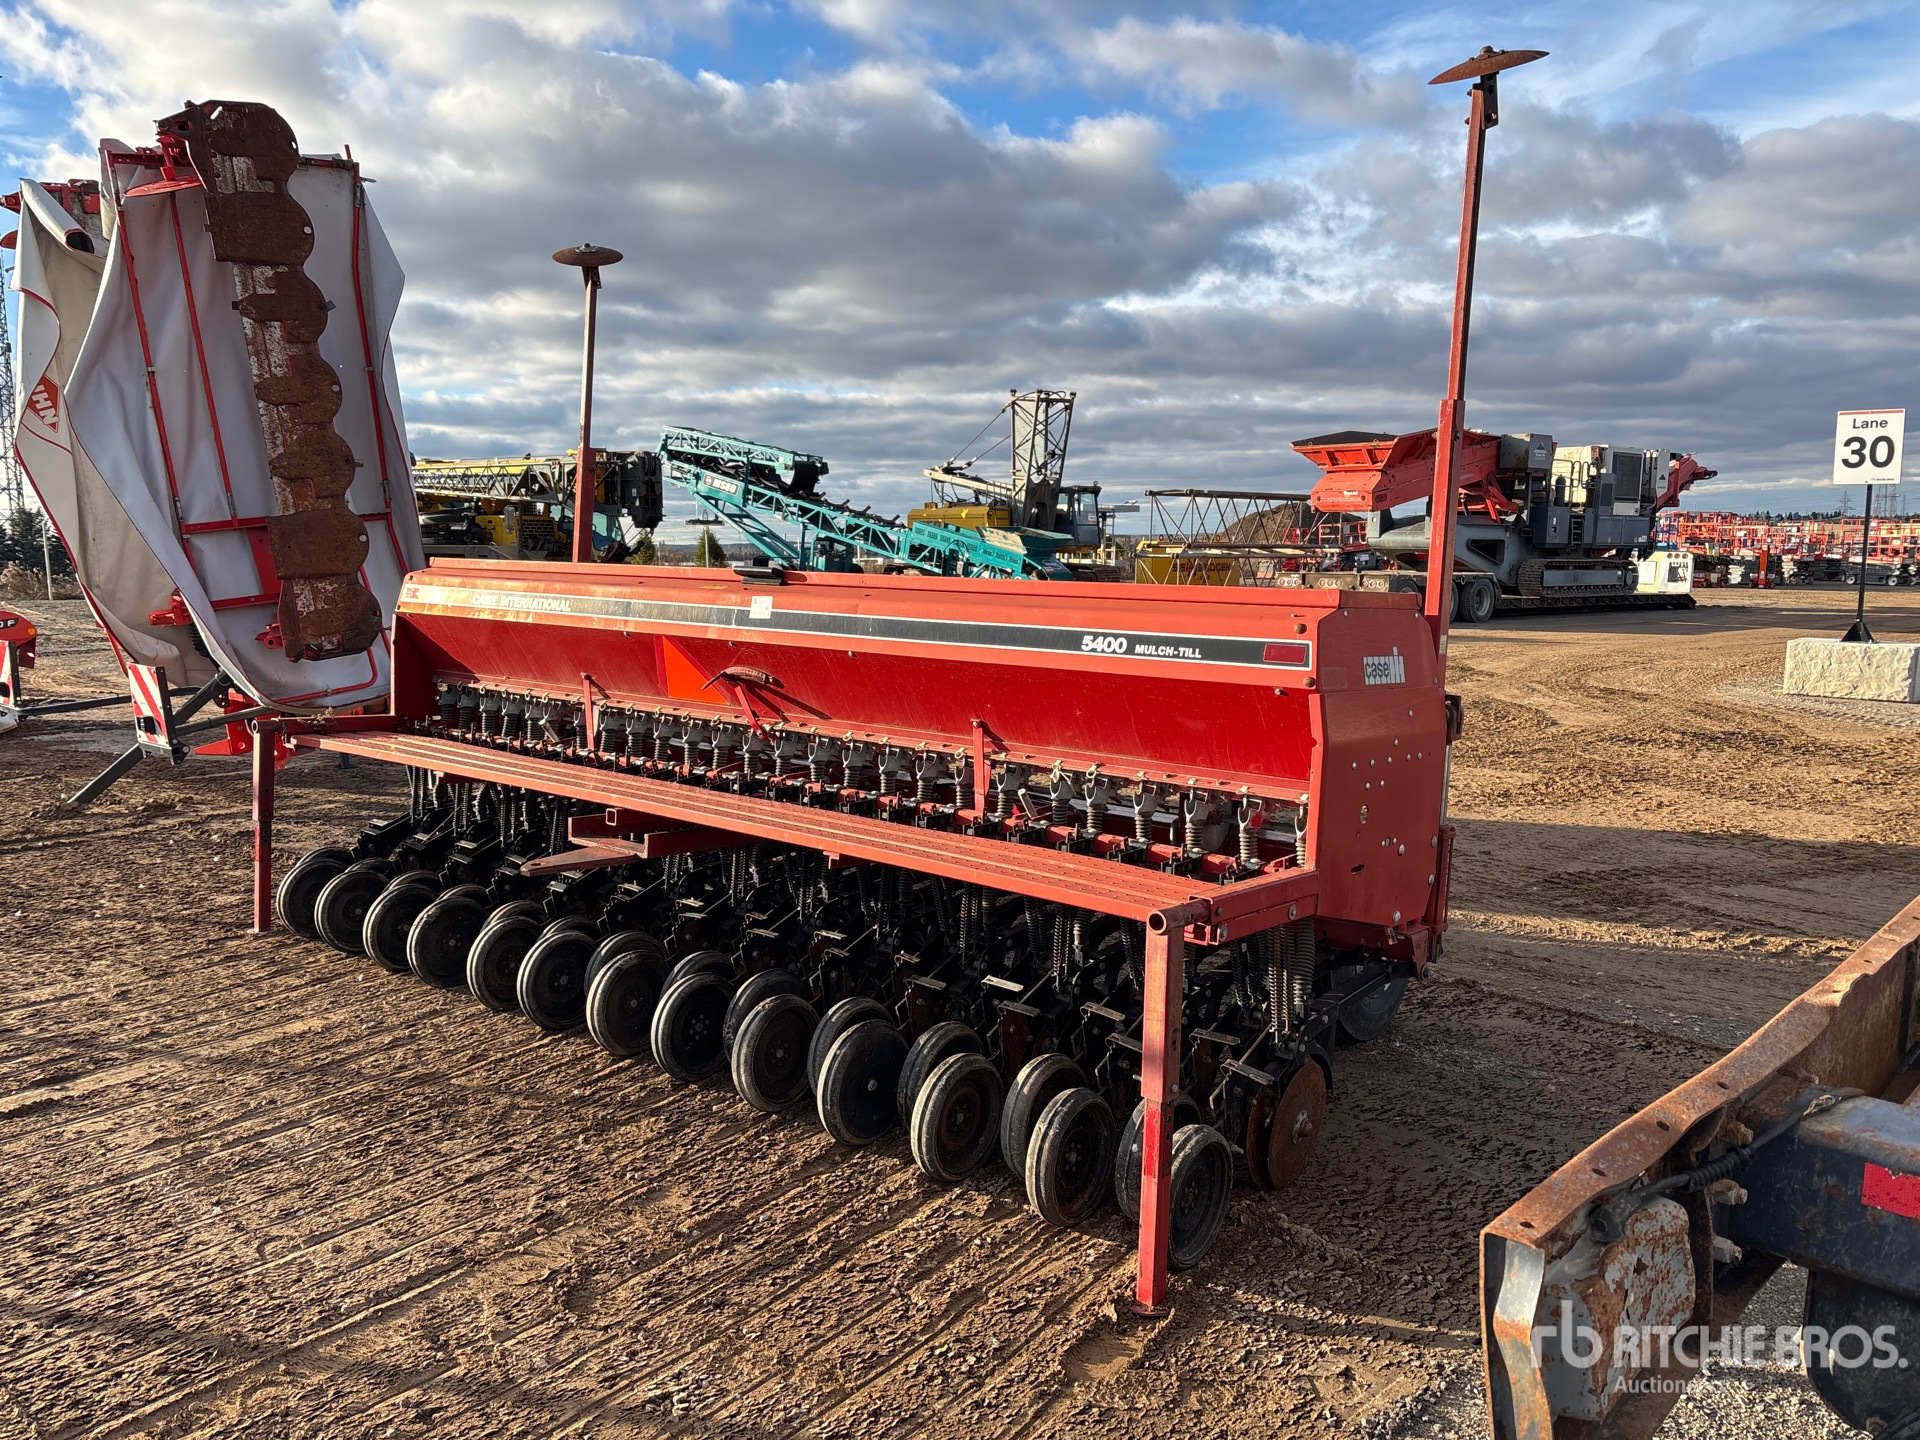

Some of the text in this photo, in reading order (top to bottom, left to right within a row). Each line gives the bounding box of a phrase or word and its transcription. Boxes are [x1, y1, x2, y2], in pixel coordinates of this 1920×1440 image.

[1852, 418, 1889, 429] Lane
[1841, 435, 1896, 469] 30
[499, 596, 571, 612] INTERNATIONAL
[1080, 635, 1202, 659] 5400 MULCH-TILL
